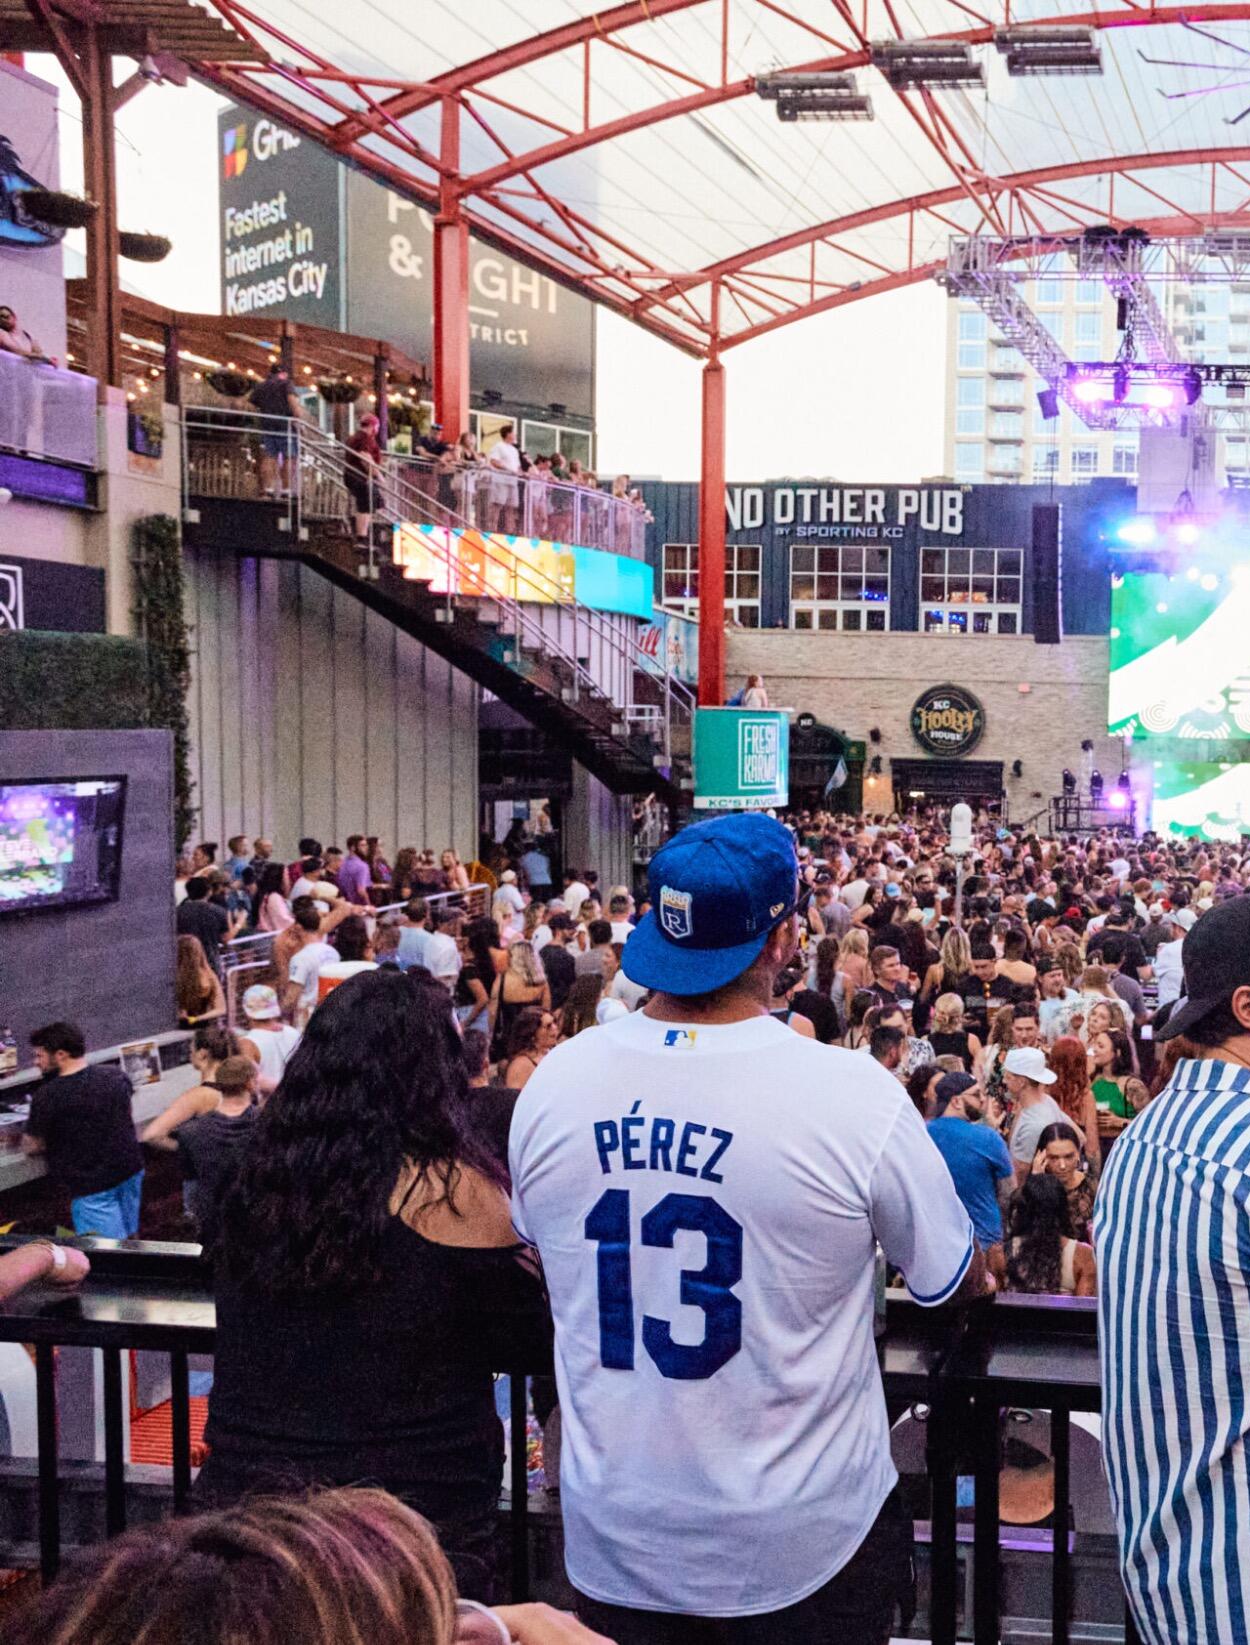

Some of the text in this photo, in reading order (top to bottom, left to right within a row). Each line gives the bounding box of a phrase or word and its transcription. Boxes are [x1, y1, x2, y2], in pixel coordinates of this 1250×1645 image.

[225, 190, 287, 241] Fastest
[225, 221, 314, 279] internet in
[225, 260, 328, 316] Kansas City
[473, 258, 557, 314] GHT
[470, 322, 529, 345] TRICT
[725, 487, 764, 531] NO
[773, 488, 886, 523] OTHER
[897, 489, 965, 536] PUB
[796, 526, 878, 538] SPORTING
[882, 527, 904, 538] KC
[744, 725, 777, 754] FRESH
[930, 730, 963, 741] HOUSE
[593, 1099, 734, 1184] PÉREZ
[584, 1188, 743, 1380] 13
